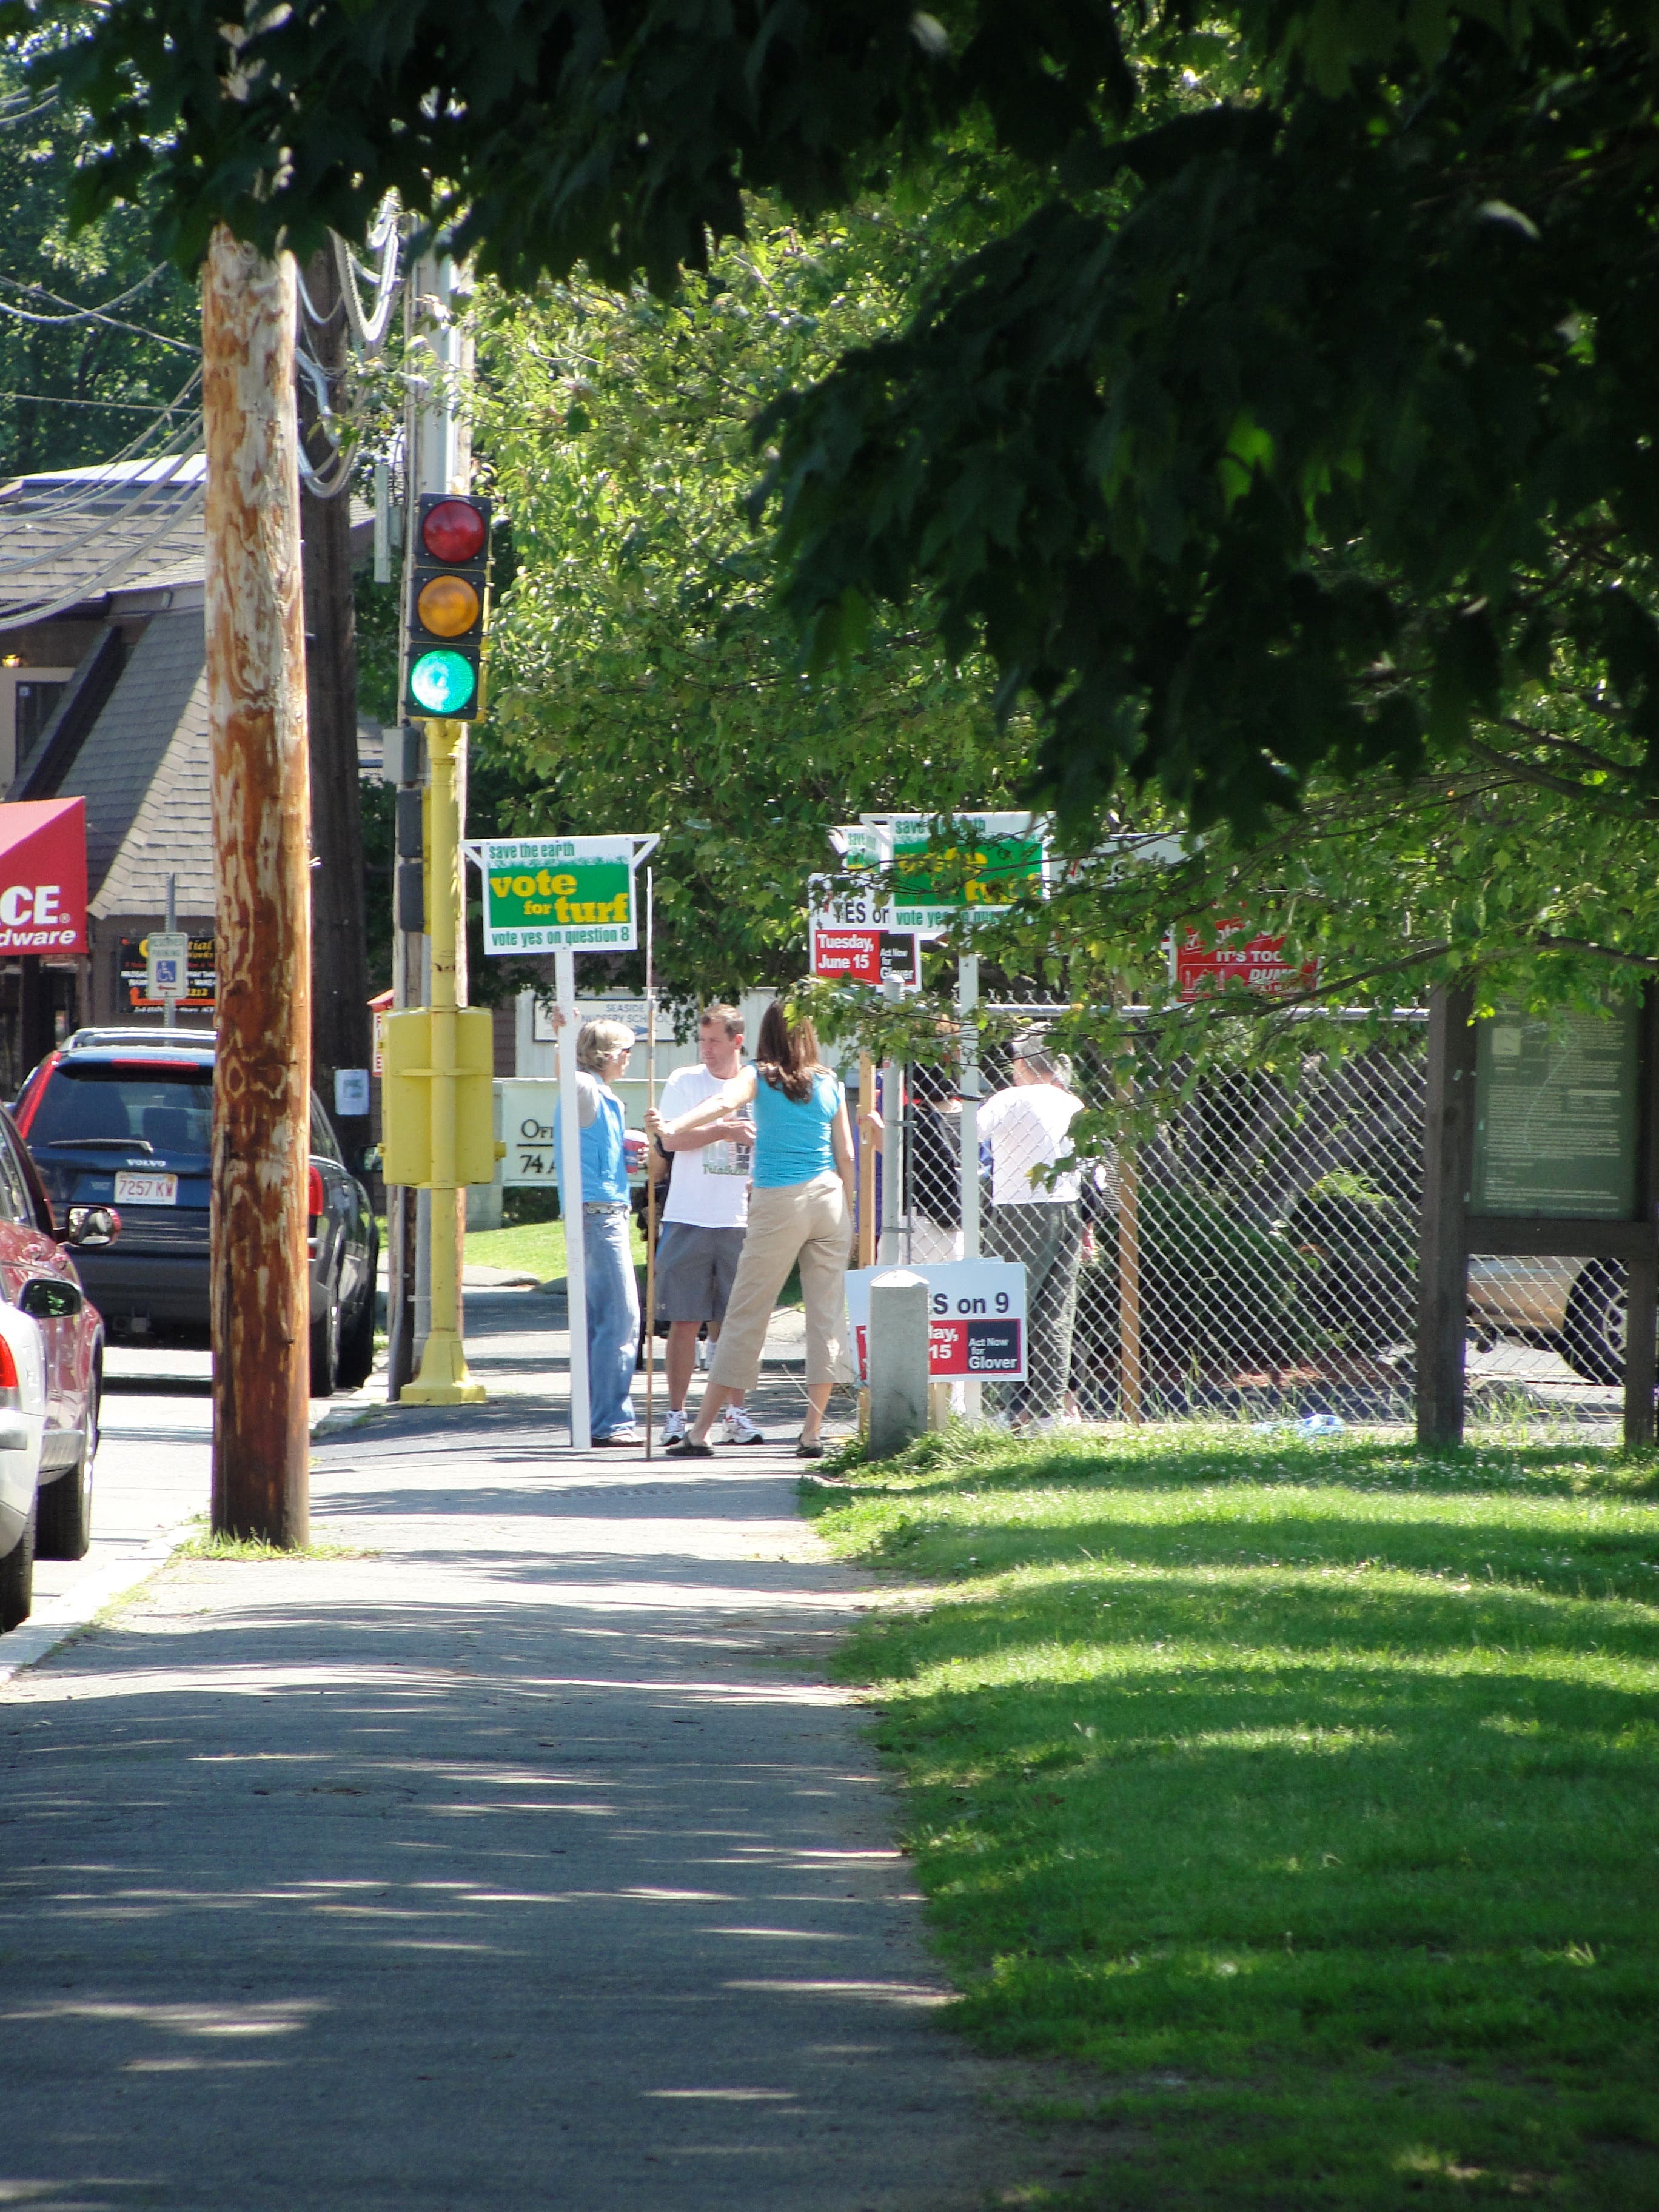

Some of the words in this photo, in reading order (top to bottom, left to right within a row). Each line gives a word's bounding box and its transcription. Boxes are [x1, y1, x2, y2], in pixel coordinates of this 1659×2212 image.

[489, 845, 517, 859] save
[520, 843, 538, 857] the
[541, 842, 575, 857] earth
[489, 869, 577, 898] vote
[523, 900, 552, 915] for
[554, 893, 629, 923] turf
[896, 910, 923, 926] vote
[492, 931, 517, 947] vote
[521, 931, 543, 948] yes
[546, 931, 561, 945] on
[565, 928, 617, 947] question
[620, 927, 629, 942] 8
[817, 934, 874, 953] Tuesday,
[880, 948, 892, 957] Act
[893, 948, 908, 957] Now
[1216, 950, 1246, 963] IT'S
[818, 954, 851, 970] June
[853, 954, 870, 969] 15
[605, 1004, 645, 1013] SEASIDE
[626, 1014, 671, 1024] SCHOL
[126, 1159, 166, 1167] VOLVO
[520, 1155, 543, 1174] 74
[119, 1180, 153, 1196] 7257
[957, 1298, 986, 1315] on
[994, 1292, 1009, 1314] 9
[968, 1338, 986, 1347] Act
[987, 1337, 1010, 1347] Now
[928, 1344, 952, 1359] 15
[971, 1347, 985, 1355] for
[968, 1356, 1018, 1369] Glover
